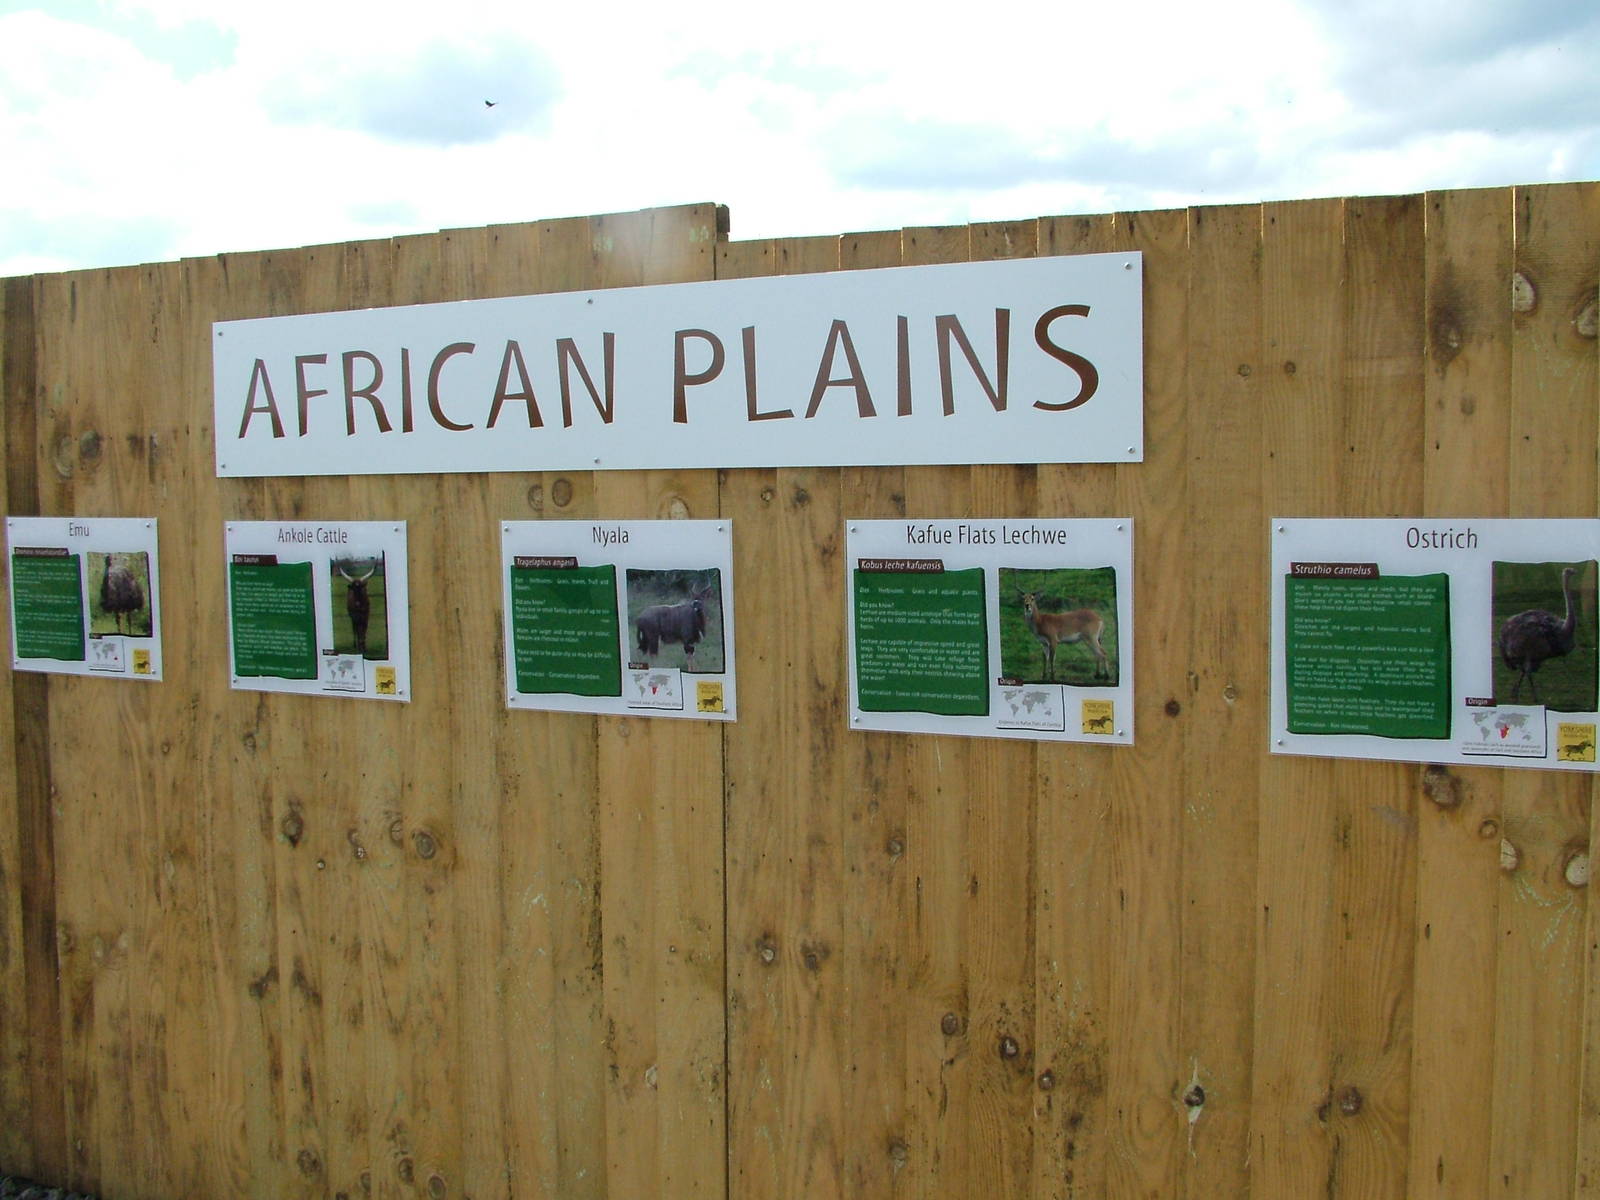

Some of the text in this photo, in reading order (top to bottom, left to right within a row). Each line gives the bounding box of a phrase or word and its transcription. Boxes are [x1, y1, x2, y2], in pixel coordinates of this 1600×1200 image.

[238, 304, 1100, 440] AFRICAN PLAINS
[69, 522, 90, 537] Emu
[278, 527, 348, 544] Ankole Cattle
[593, 526, 629, 547] Nyala
[907, 525, 1067, 545] Kafue Flats Lechwe
[1406, 527, 1478, 549] Ostrich
[861, 560, 941, 570] Kobus leche kafuensis
[1295, 564, 1371, 576] Struthio camelus
